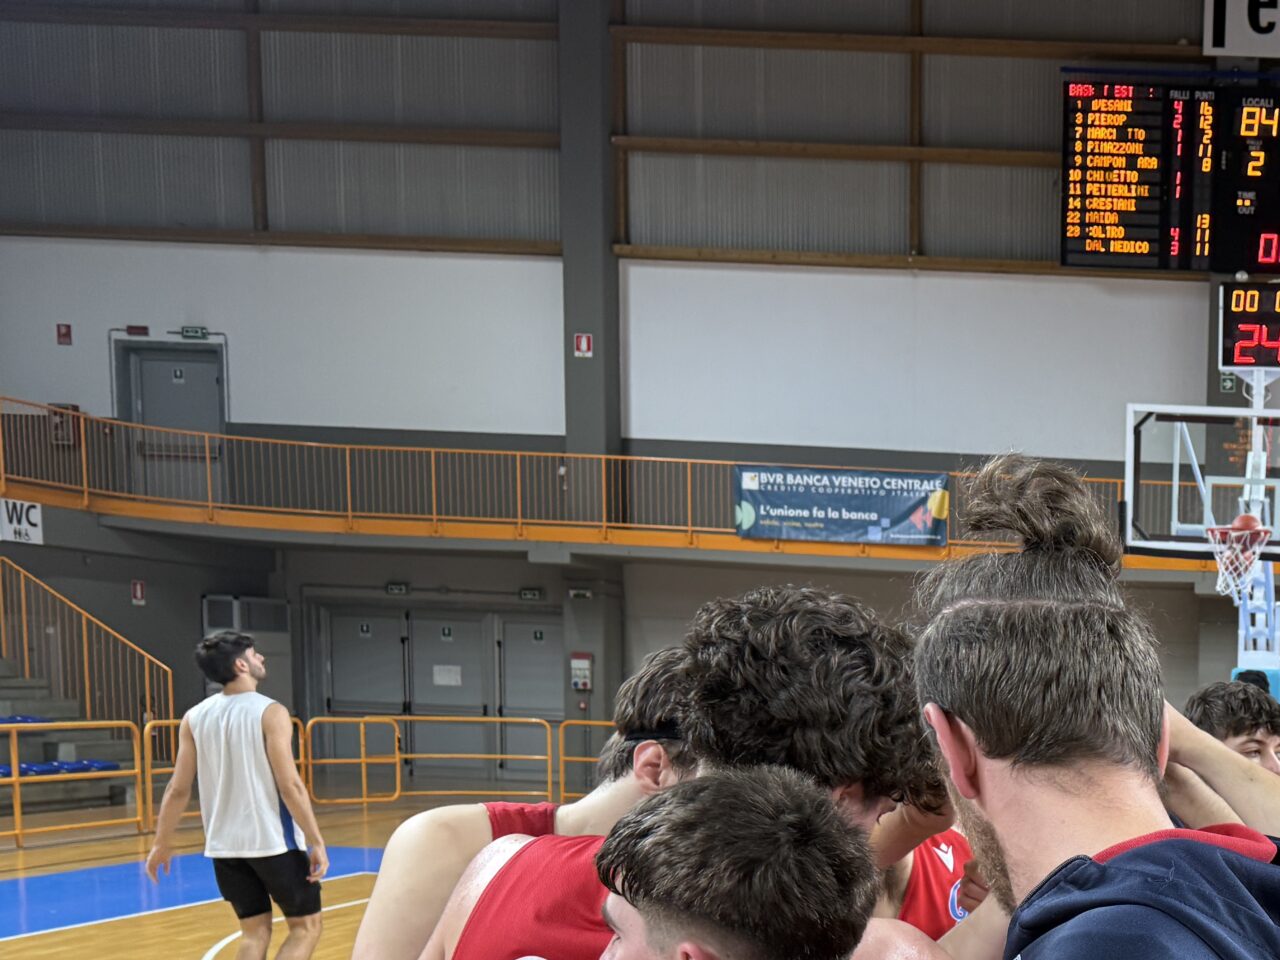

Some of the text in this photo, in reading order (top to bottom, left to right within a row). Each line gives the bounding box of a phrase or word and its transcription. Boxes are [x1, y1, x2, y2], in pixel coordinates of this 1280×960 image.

[1174, 100, 1183, 114] 4
[1200, 101, 1212, 115] 16
[1242, 98, 1274, 107] LOCALI
[1076, 113, 1082, 124] 3
[1173, 115, 1182, 128] 2
[1200, 115, 1212, 129] 12
[1240, 107, 1279, 136] 84
[1075, 127, 1082, 139] 7
[1177, 129, 1182, 142] 1
[1203, 130, 1212, 144] 2
[1177, 144, 1182, 156] 1
[1199, 144, 1212, 157] 11
[1074, 156, 1082, 166] 9
[1202, 158, 1211, 172] 8
[1247, 152, 1265, 176] 2
[1069, 169, 1081, 181] 10
[1176, 171, 1181, 184] 1
[1069, 183, 1081, 194] 11
[1176, 186, 1180, 198] 1
[1068, 196, 1081, 209] 14
[1238, 206, 1255, 215] OUT
[1067, 211, 1080, 223] 22
[1197, 214, 1210, 228] 13
[1170, 228, 1179, 240] 4
[1196, 229, 1210, 241] 11
[1086, 240, 1105, 252] DAL
[1170, 241, 1179, 255] 3
[1196, 242, 1209, 256] 11
[1232, 290, 1259, 312] 00
[760, 472, 942, 490] BVR BANCA VENETO CENTRALE
[760, 485, 804, 493] CREDITO
[812, 487, 885, 496] COOPERATIVO
[5, 500, 38, 528] WC
[760, 504, 878, 520] L'unione fa la banca
